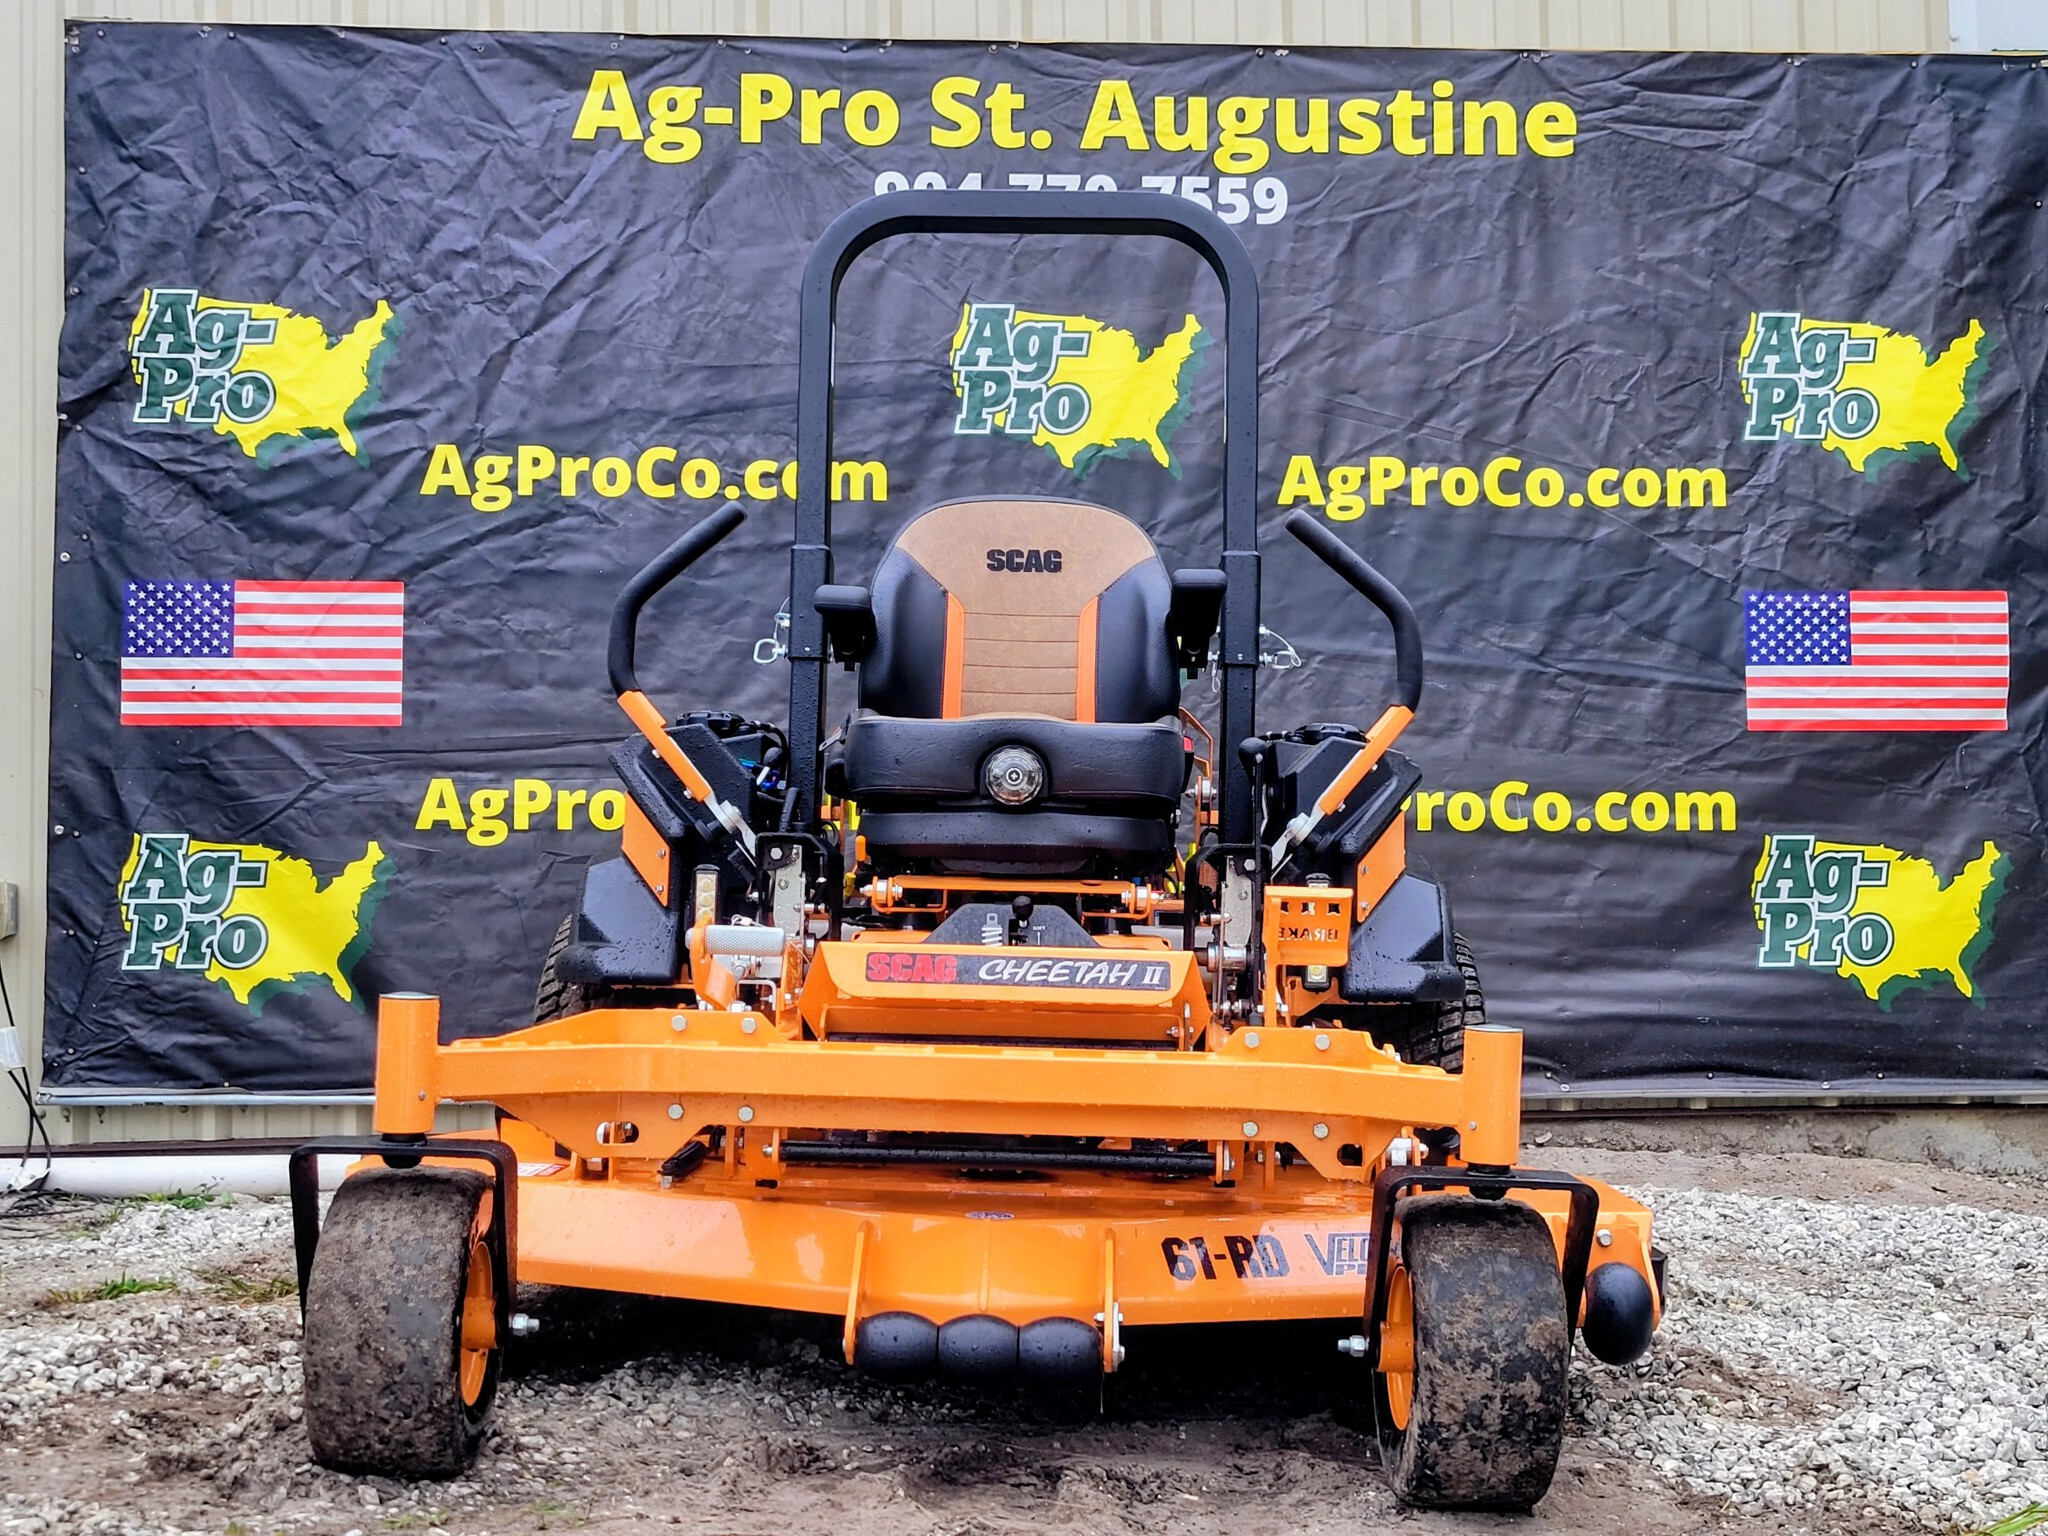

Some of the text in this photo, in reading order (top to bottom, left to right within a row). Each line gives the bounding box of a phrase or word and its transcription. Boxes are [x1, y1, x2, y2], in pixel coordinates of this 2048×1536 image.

[572, 69, 1578, 176] Ag-Pro St. Augustine
[132, 288, 276, 374] Ag-
[953, 303, 1090, 386] Ag-
[1741, 312, 1877, 392] Ag-
[132, 357, 276, 423] Pro
[953, 369, 1091, 435] Pro
[1743, 376, 1880, 441] Pro
[1277, 454, 1728, 522] AgProCo.com
[986, 548, 1063, 574] SCAG
[1399, 779, 1738, 833] roCo.com
[122, 833, 267, 917] Ag-
[1755, 834, 1889, 916] Ag-
[121, 901, 268, 970] Pro
[1757, 901, 1894, 968] Pro
[866, 952, 1169, 986] SCAG CHEETAH II
[1160, 1233, 1291, 1283] 61-RD
